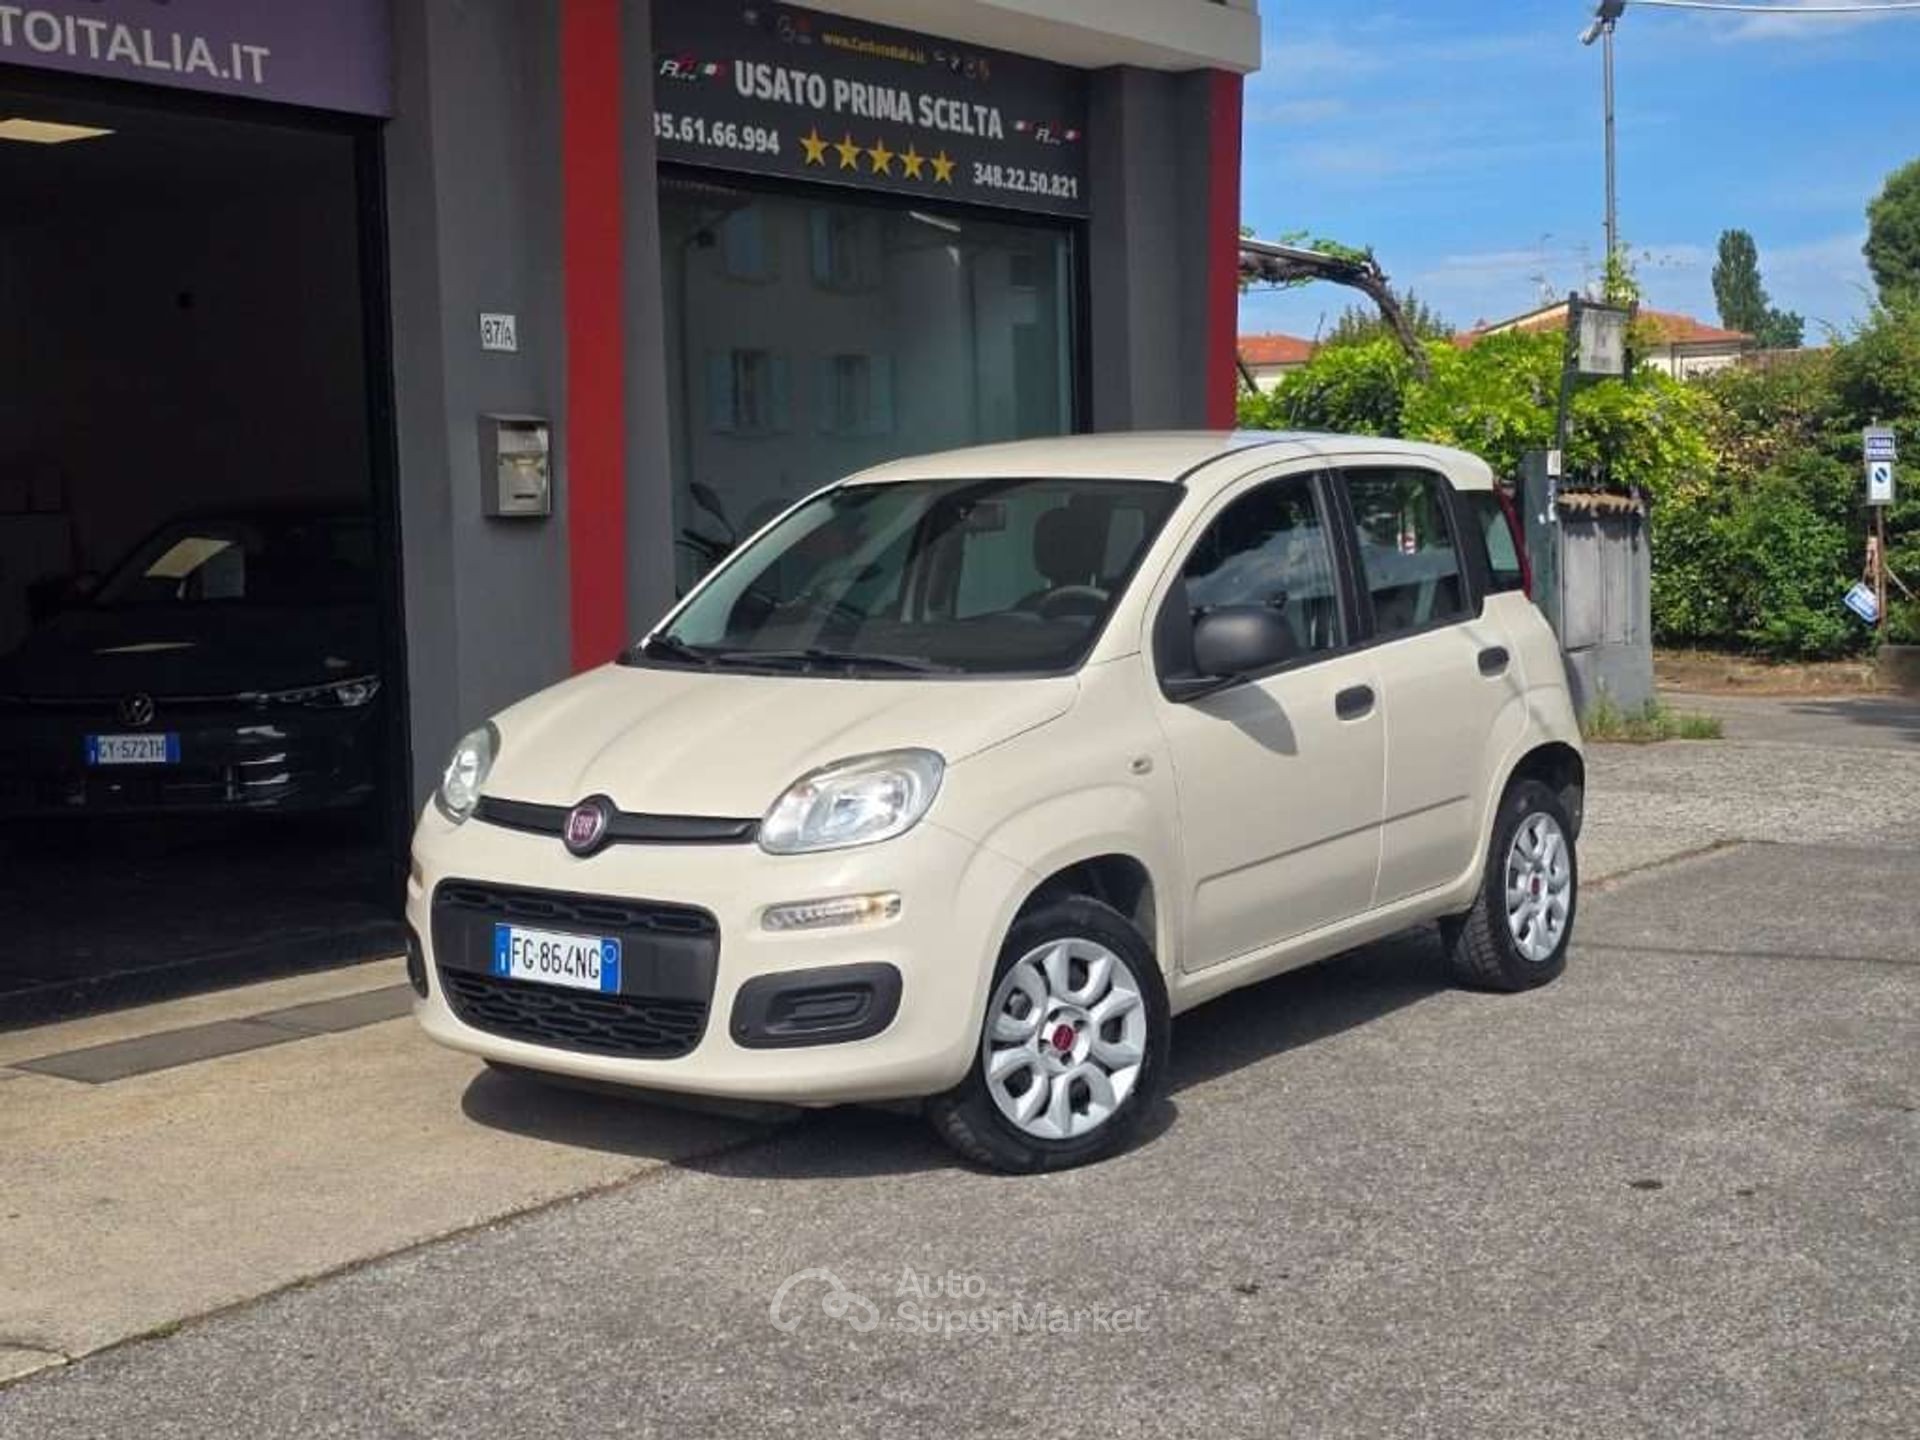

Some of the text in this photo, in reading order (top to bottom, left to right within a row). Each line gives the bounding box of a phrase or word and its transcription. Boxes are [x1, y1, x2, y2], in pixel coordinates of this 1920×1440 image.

[0, 5, 270, 84] TOITALIA.IT
[734, 60, 1004, 140] USATO PRIMA SCELTA
[512, 937, 534, 969] FG
[539, 941, 600, 979] 864NG
